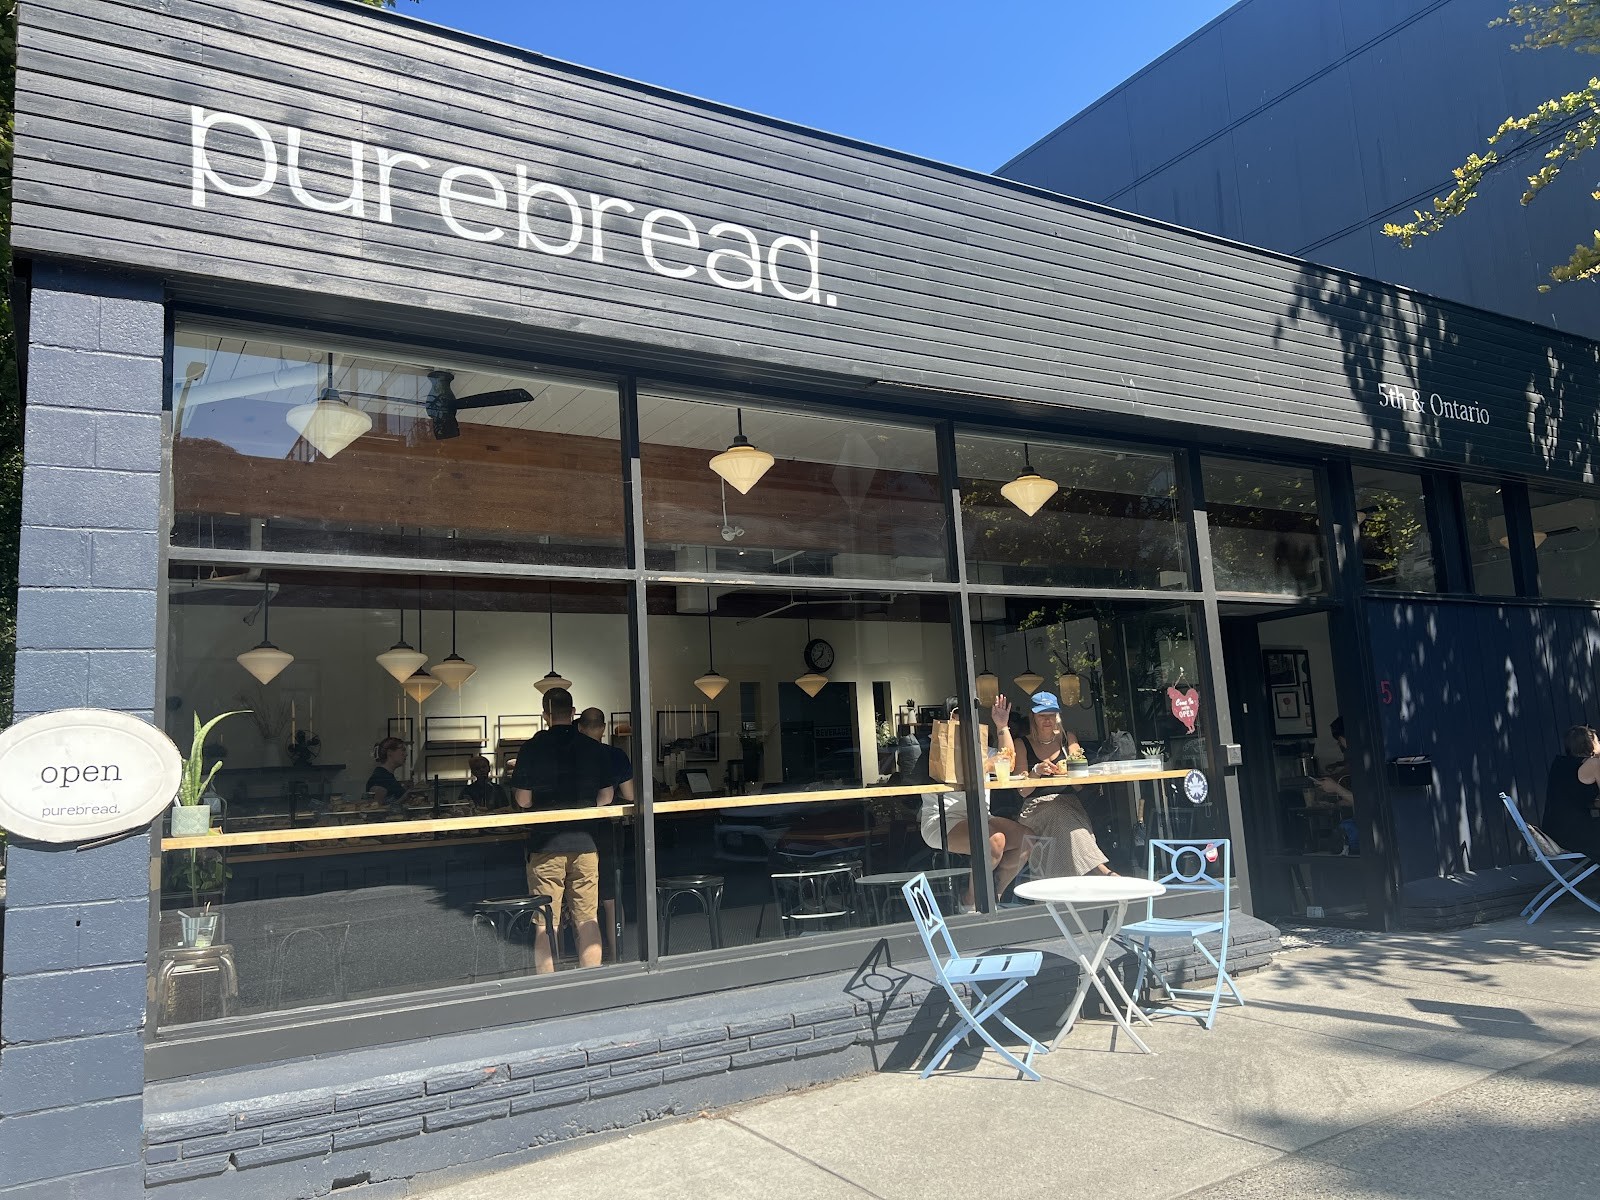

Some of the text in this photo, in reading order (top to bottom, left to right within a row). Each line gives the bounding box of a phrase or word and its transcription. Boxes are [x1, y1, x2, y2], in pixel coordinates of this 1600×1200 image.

[190, 105, 839, 307] purebread.
[1377, 382, 1490, 425] 5th & Ontario
[1178, 709, 1195, 718] OPEN
[41, 764, 122, 788] open
[42, 804, 121, 818] purebread.
